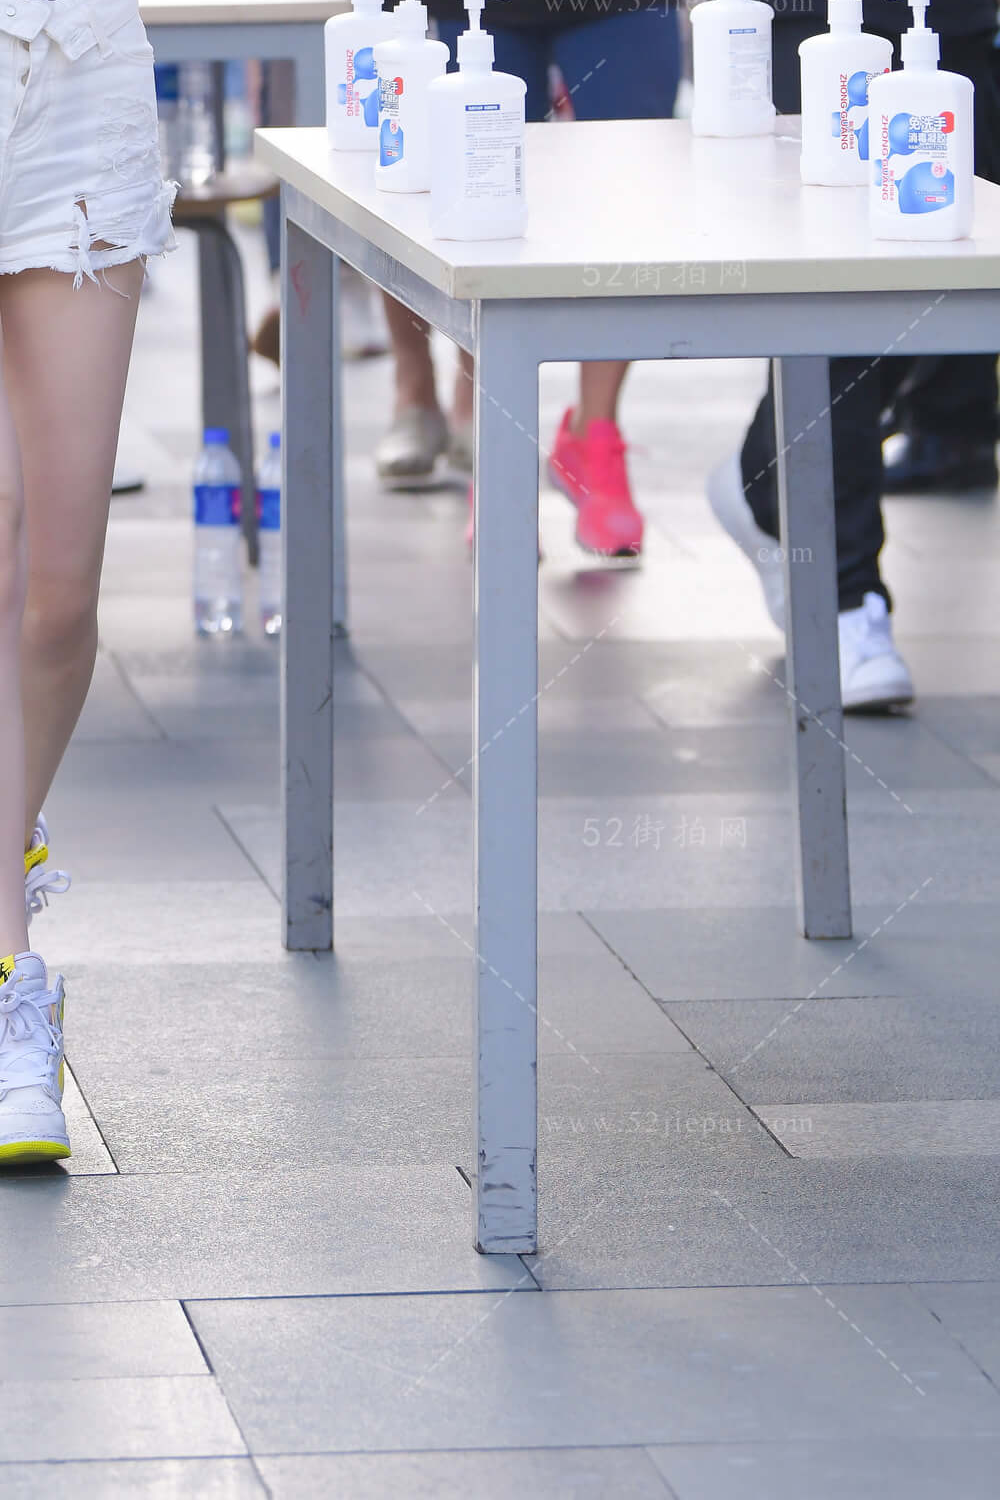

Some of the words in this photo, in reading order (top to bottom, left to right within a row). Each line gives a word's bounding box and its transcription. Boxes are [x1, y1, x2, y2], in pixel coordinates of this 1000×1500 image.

[840, 74, 848, 109] ZHONG
[840, 111, 848, 150] GUANG
[908, 115, 947, 131] 免洗手
